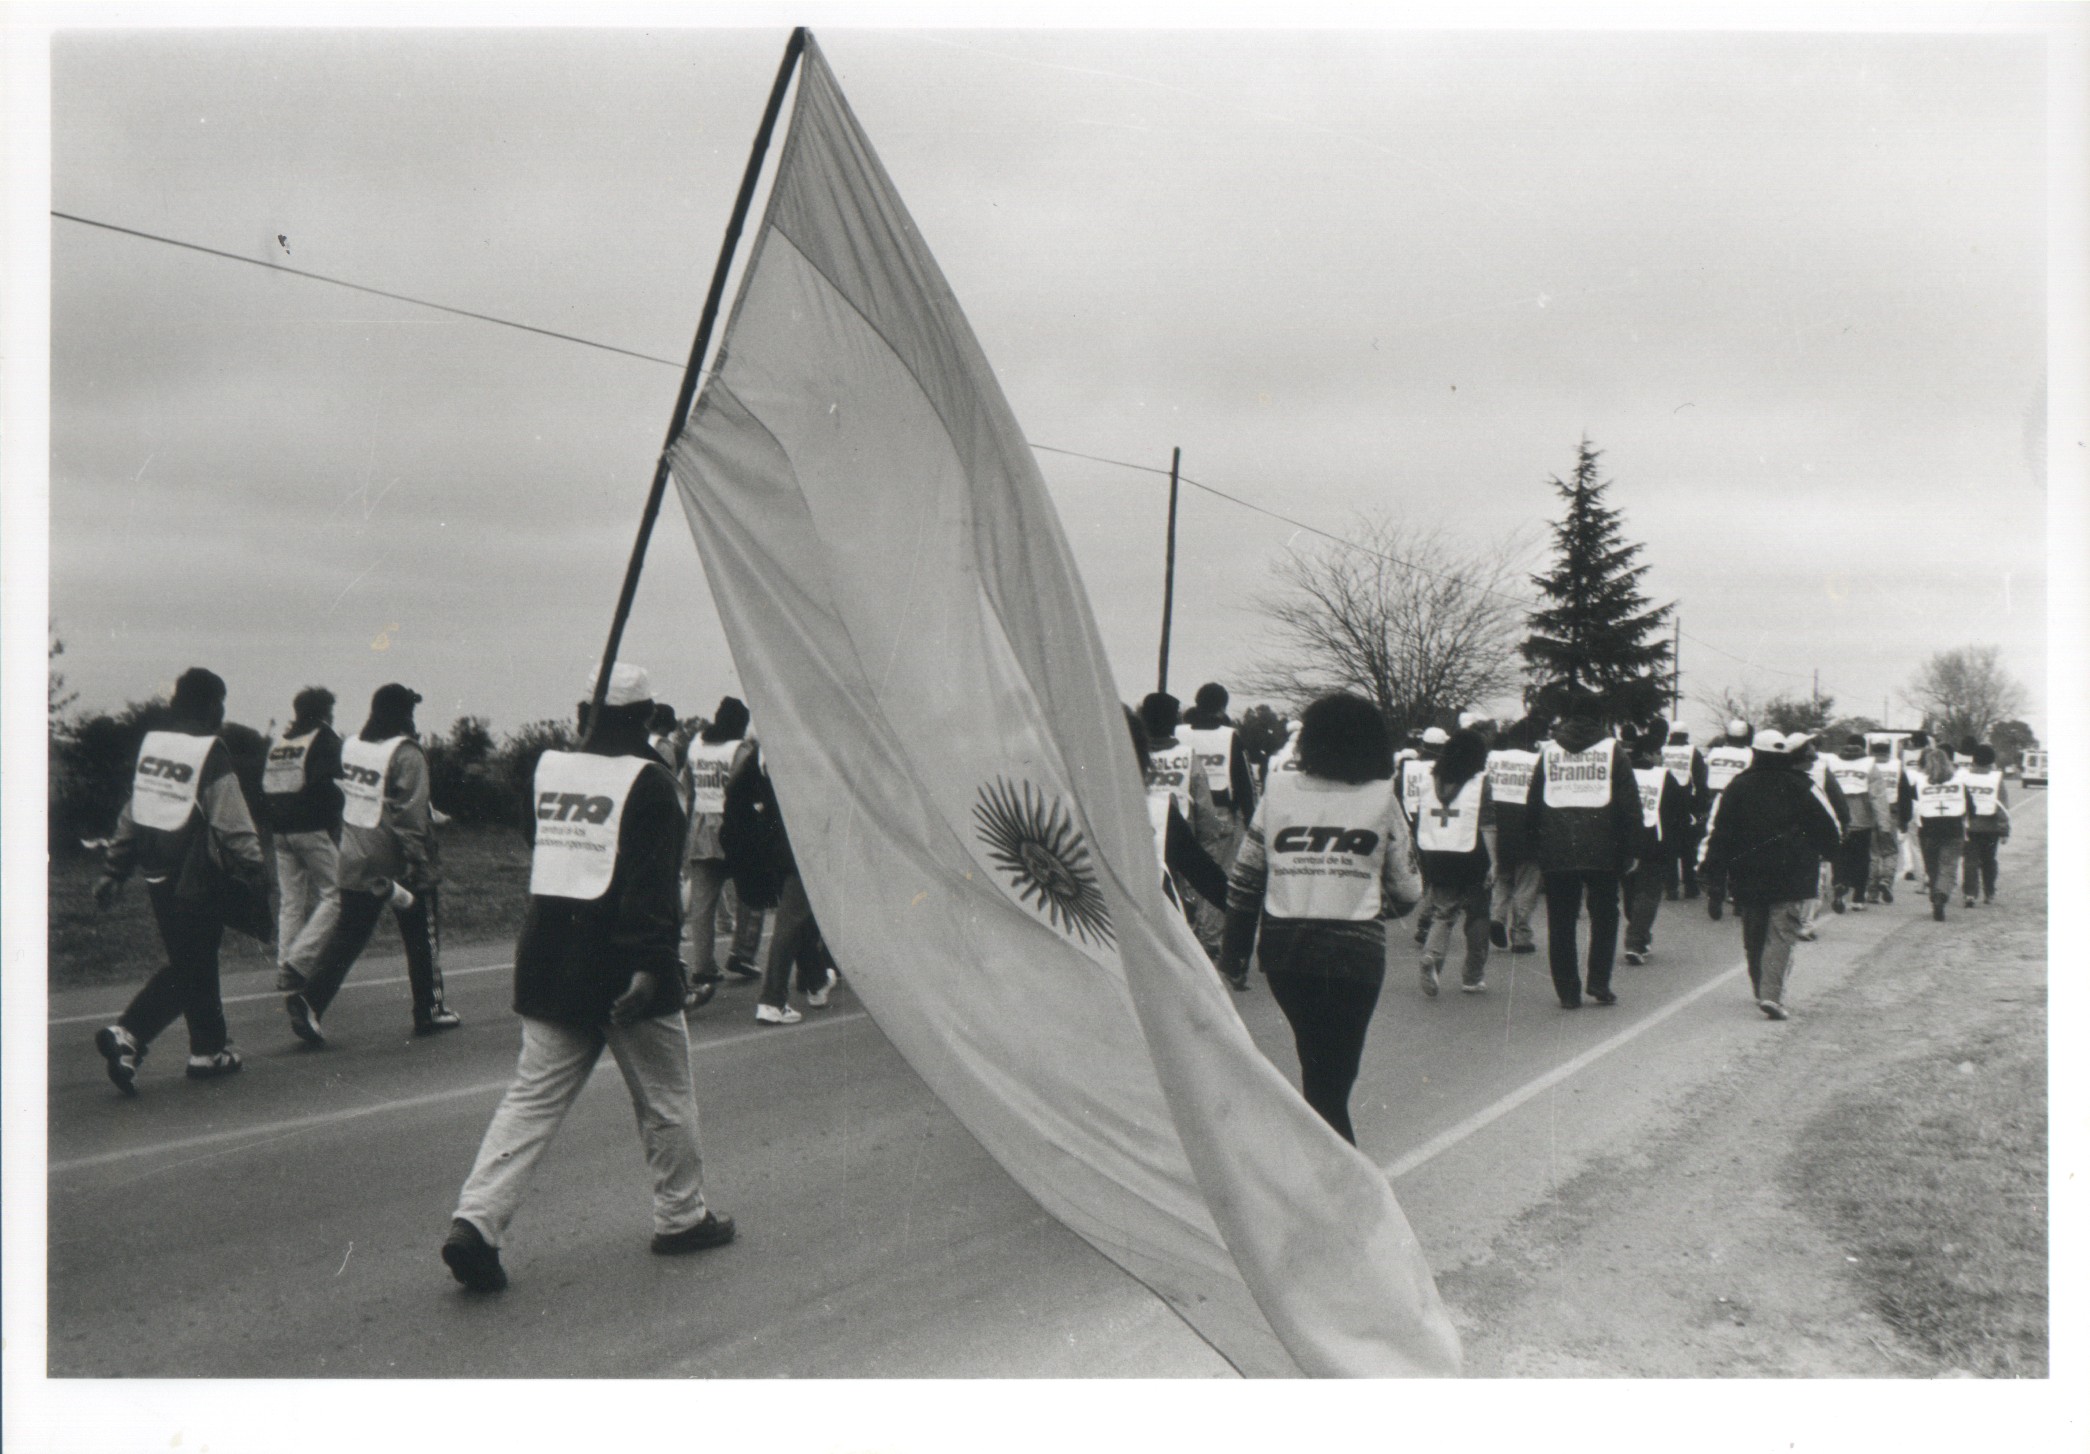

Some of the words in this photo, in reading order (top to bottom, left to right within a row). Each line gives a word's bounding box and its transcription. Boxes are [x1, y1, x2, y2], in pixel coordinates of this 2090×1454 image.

[1196, 753, 1225, 767] TA
[1548, 751, 1560, 763] La
[1563, 749, 1608, 763] Marcha
[138, 756, 194, 784] CTA
[1711, 758, 1746, 770] CTA
[1549, 763, 1607, 782] Grande
[1922, 785, 1960, 796] CTA
[536, 792, 614, 826] CTA
[1274, 826, 1379, 857] CTA
[1292, 856, 1325, 865] central
[1326, 856, 1339, 865] de
[1341, 856, 1354, 866] los
[1328, 868, 1372, 881] argentinos
